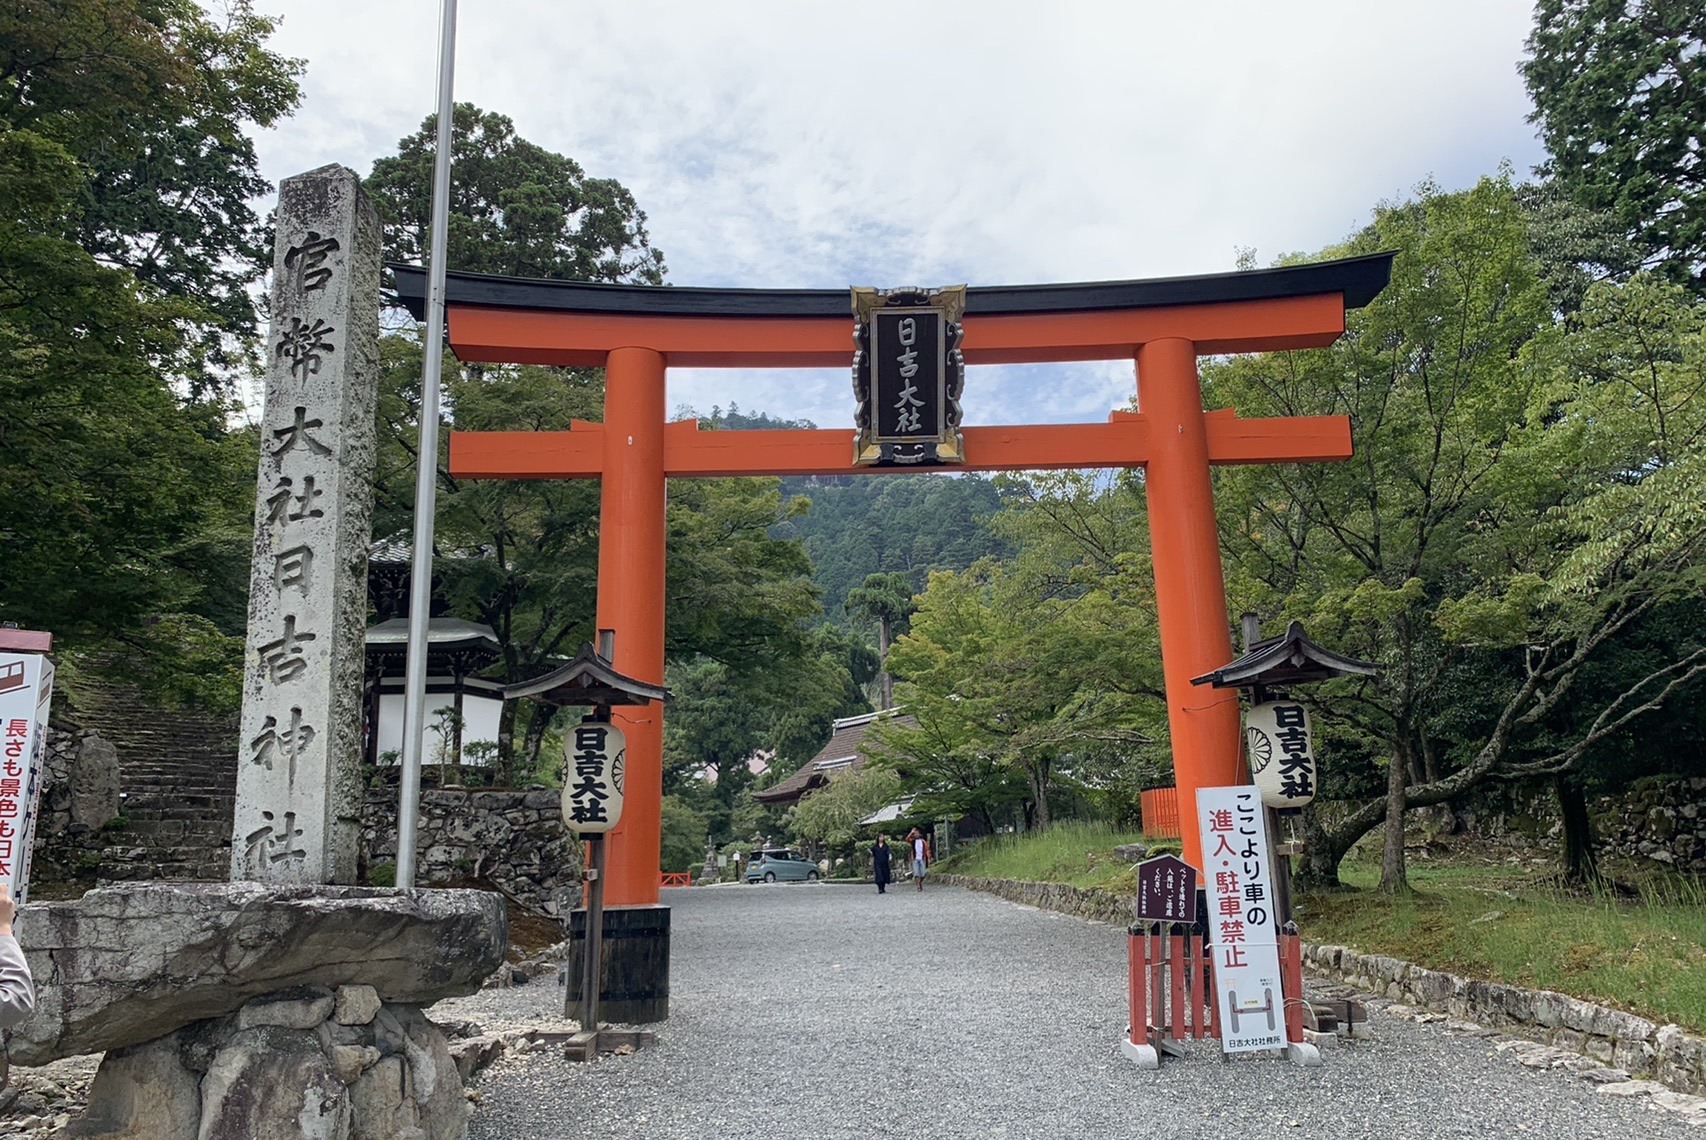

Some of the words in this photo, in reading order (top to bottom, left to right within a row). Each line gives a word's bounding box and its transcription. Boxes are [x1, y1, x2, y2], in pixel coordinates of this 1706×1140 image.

[893, 317, 926, 433] 日吉大社
[245, 231, 340, 869] 官幣大社日吉神社
[0, 718, 28, 888] 長さも景色も日本
[569, 727, 609, 824] 日吉大社
[1273, 705, 1313, 799] 日吉大社
[1209, 809, 1248, 969] 進入・駐車禁止
[1237, 794, 1267, 926] ここより車の
[1228, 1035, 1281, 1048] 日吉大社社務所
